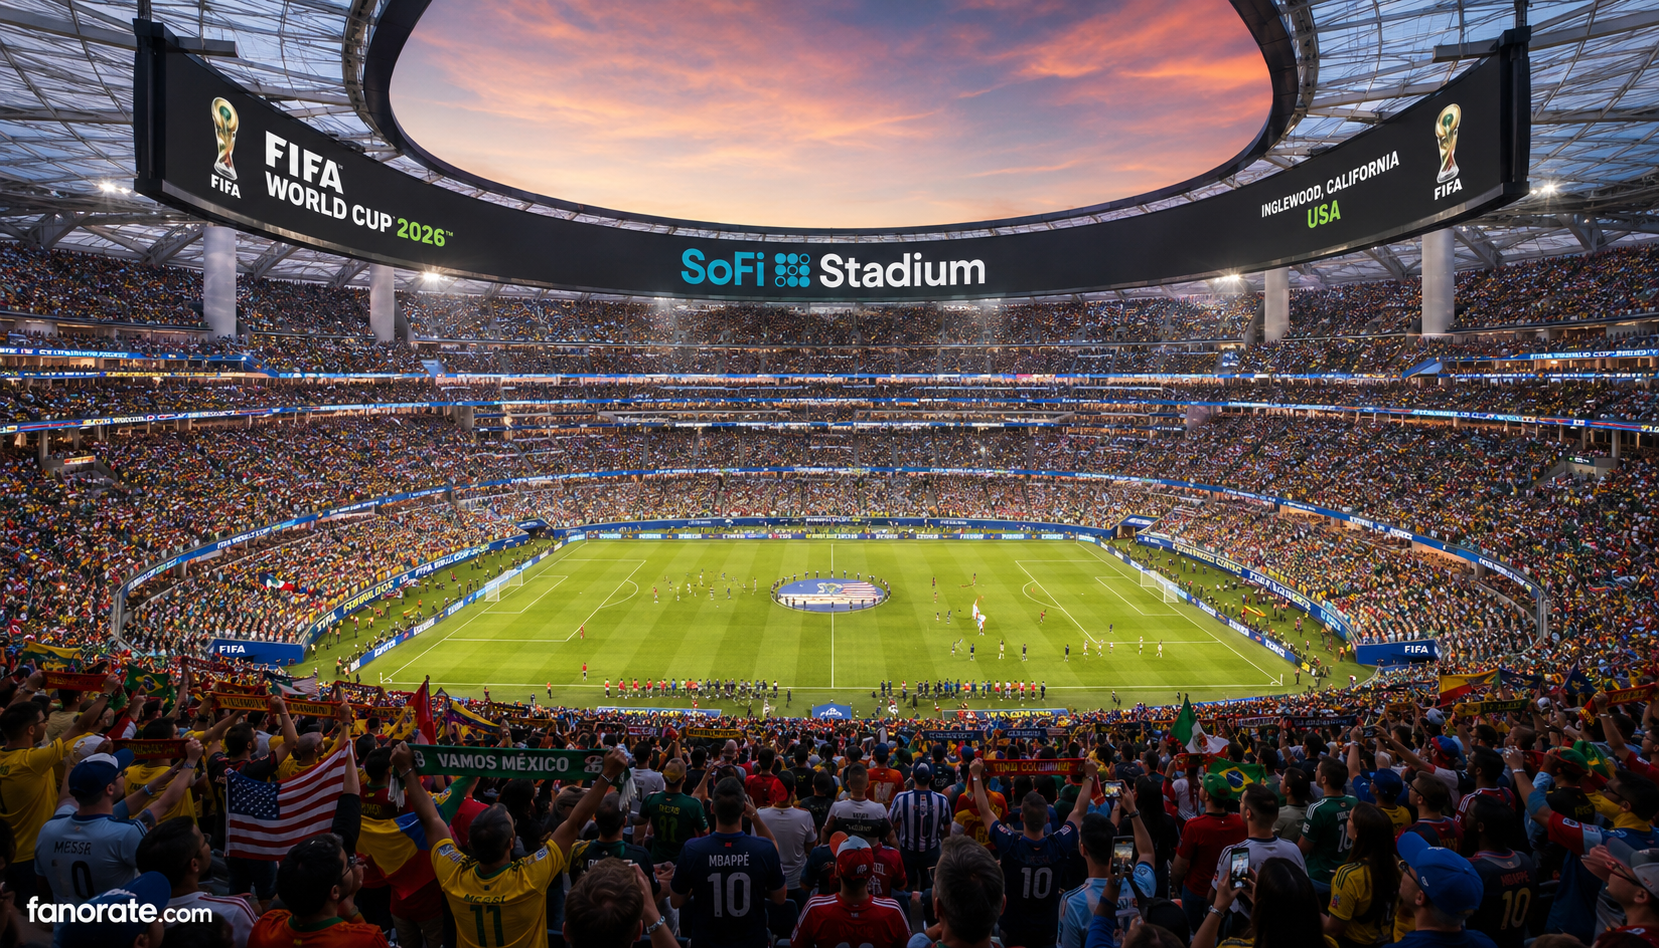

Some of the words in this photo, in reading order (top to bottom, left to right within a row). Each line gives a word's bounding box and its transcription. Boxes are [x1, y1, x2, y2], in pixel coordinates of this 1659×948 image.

[211, 173, 241, 199] FIFA
[1261, 184, 1324, 218] INGLEWOOD,
[1326, 150, 1400, 195] CALIFORNIA
[1434, 177, 1463, 200] FIFA
[265, 171, 347, 220] WORLD
[352, 205, 394, 233] CUP
[1307, 199, 1341, 229] USA
[681, 248, 765, 287] SoFi
[819, 252, 986, 289] Stadium
[219, 645, 246, 654] FIFA
[1404, 645, 1429, 654] FIFA
[437, 753, 498, 769] VAMOS
[501, 752, 570, 772] MÉXICO
[708, 851, 750, 867] MBAPPÉ
[707, 871, 751, 918] 10
[1021, 866, 1053, 899] 10
[1501, 886, 1532, 931] 10
[470, 904, 505, 947] 11
